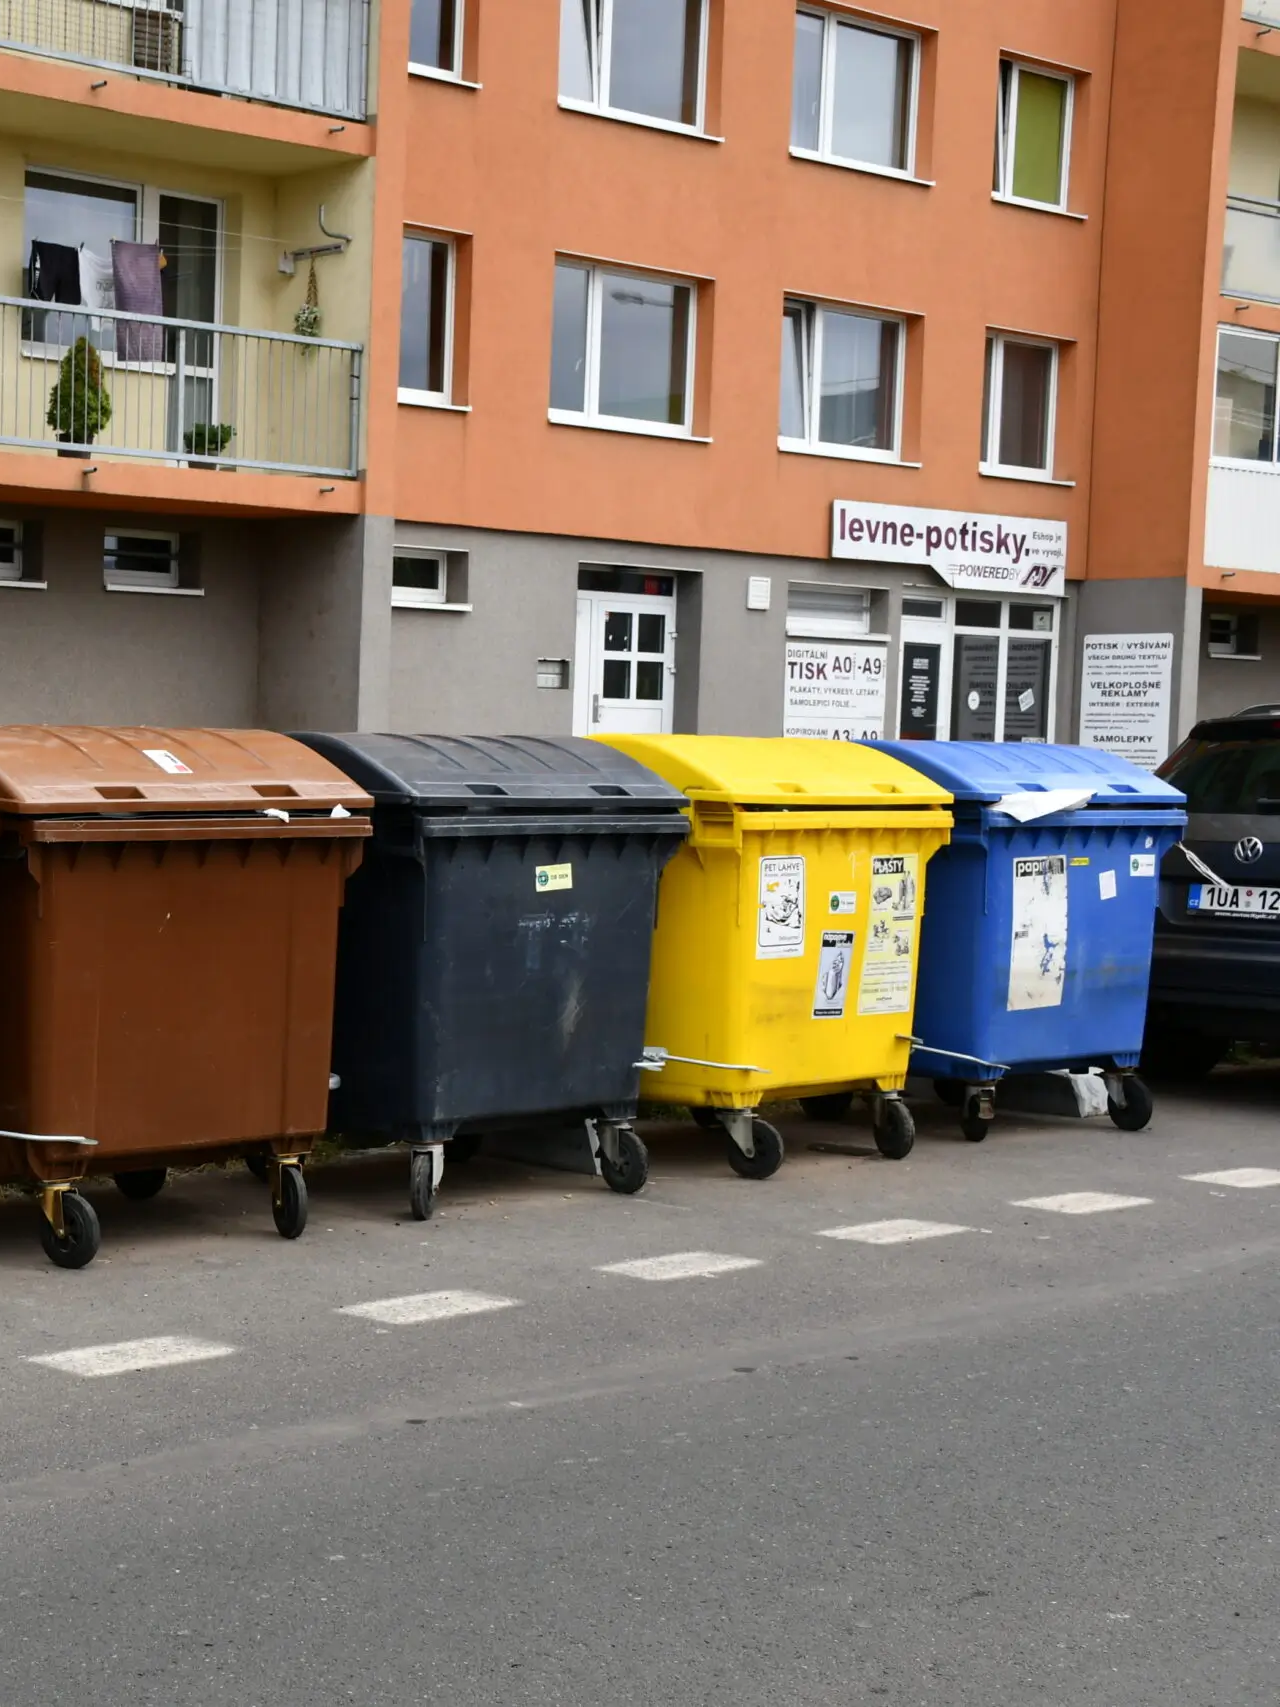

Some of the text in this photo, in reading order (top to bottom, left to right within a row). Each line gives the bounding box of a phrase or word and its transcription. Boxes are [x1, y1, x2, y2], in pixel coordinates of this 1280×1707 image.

[787, 661, 828, 681] TISK
[832, 656, 852, 673] A0
[1090, 680, 1161, 690] VELKOPLOŠNÉ
[1093, 735, 1153, 743] SAMOLEPKY
[764, 863, 776, 872] PET
[1207, 887, 1239, 909] 1UA
